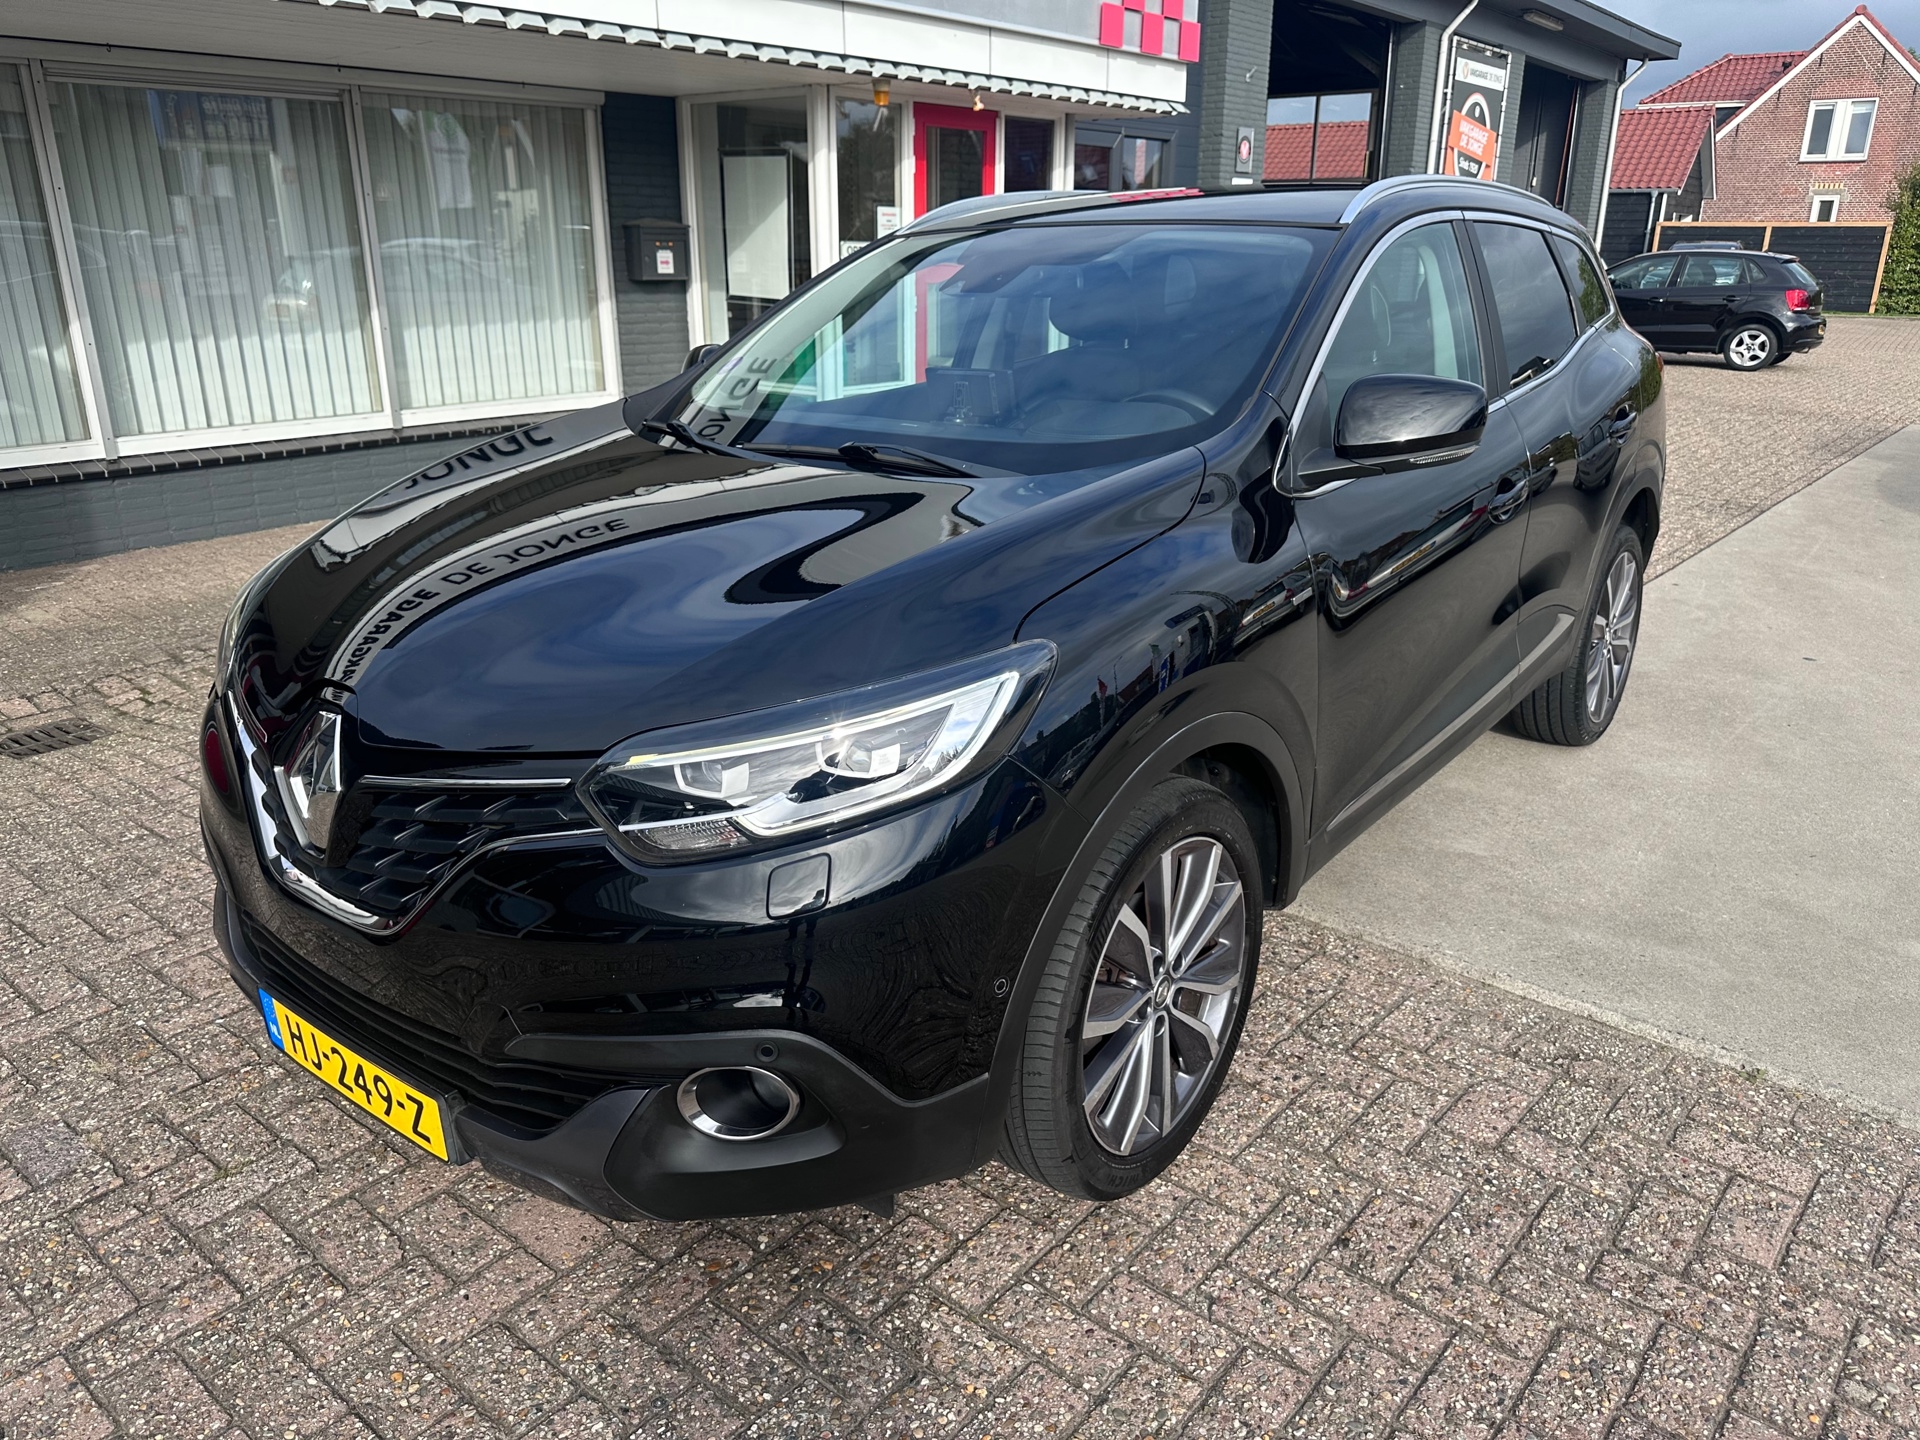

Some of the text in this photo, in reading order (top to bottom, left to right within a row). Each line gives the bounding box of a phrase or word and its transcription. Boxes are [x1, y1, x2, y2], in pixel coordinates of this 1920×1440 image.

[1459, 119, 1489, 145] VAKGARAGE
[1459, 134, 1468, 148] DE
[269, 1022, 281, 1039] NL
[285, 1013, 432, 1146] HJ-249-Z
